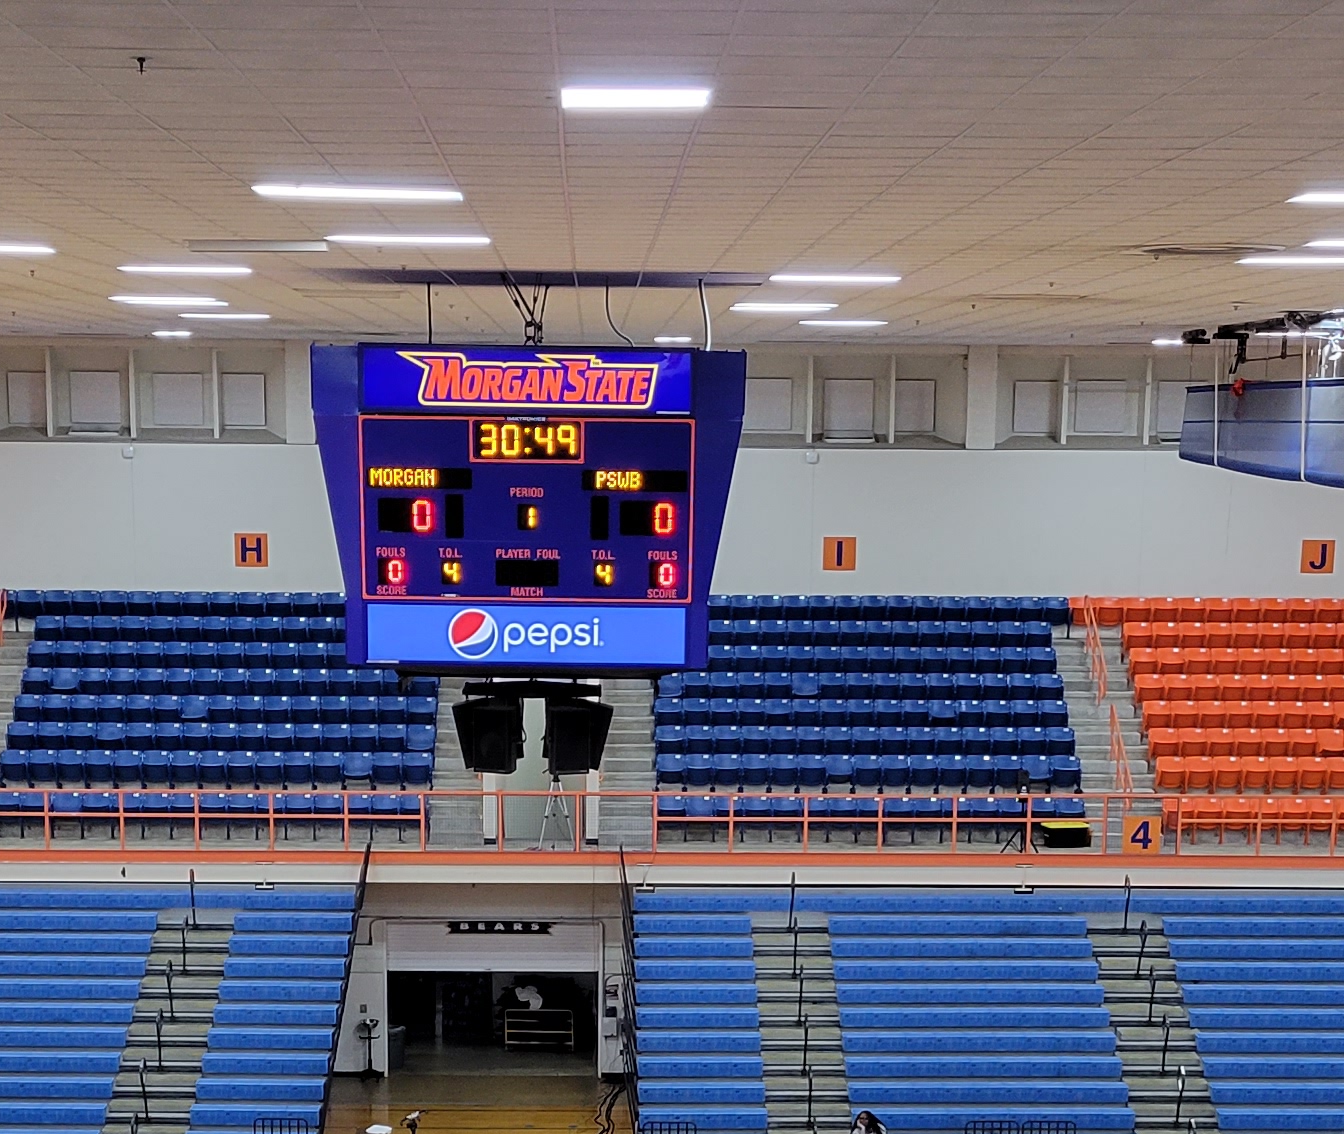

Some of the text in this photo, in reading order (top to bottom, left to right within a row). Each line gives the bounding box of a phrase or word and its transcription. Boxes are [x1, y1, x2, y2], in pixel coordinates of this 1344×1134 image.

[423, 358, 649, 403] MORGAN STATE
[479, 423, 577, 457] 30:49
[368, 467, 437, 487] MORGAN
[595, 470, 642, 489] PSWB
[509, 487, 544, 498] PERIOD
[412, 500, 432, 532] 0
[527, 506, 536, 528] 1
[654, 502, 674, 534] 0
[240, 537, 262, 563] H
[375, 547, 406, 558] FOULS
[495, 549, 561, 560] PLAYER FOUL
[647, 550, 678, 561] FOULS
[836, 540, 843, 567] I
[1308, 543, 1328, 570] J
[387, 560, 403, 584] 0
[442, 562, 462, 582] 4
[594, 563, 613, 584] 4
[659, 563, 675, 587] 0
[376, 585, 407, 596] SCORE
[510, 586, 544, 598] MATCH
[646, 588, 677, 599] SCORE
[503, 617, 601, 653] pepsi
[1130, 820, 1153, 850] 4
[459, 922, 540, 931] BEARS
